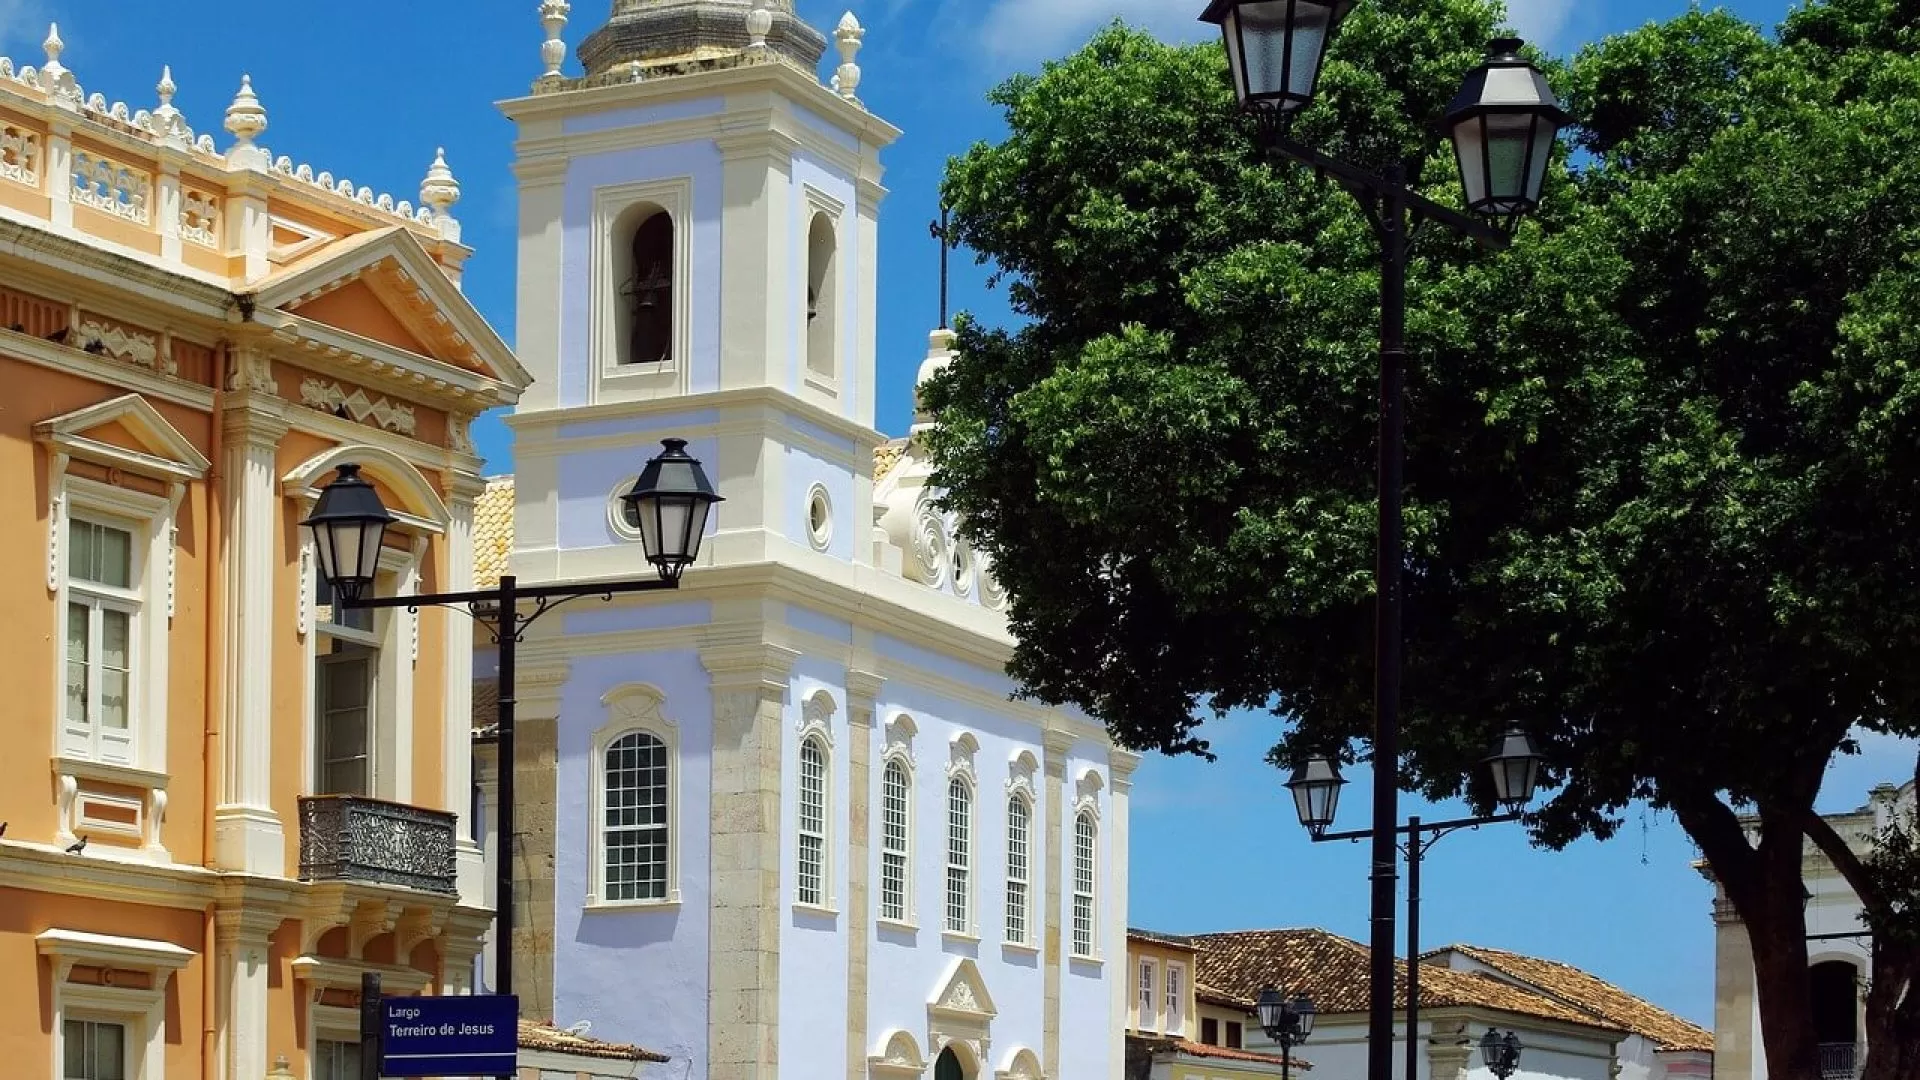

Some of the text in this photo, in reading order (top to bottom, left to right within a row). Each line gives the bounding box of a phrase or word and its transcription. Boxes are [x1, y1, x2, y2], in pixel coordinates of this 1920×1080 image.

[389, 1005, 420, 1019] Largo
[389, 1022, 494, 1037] Terreiro de Jesus
